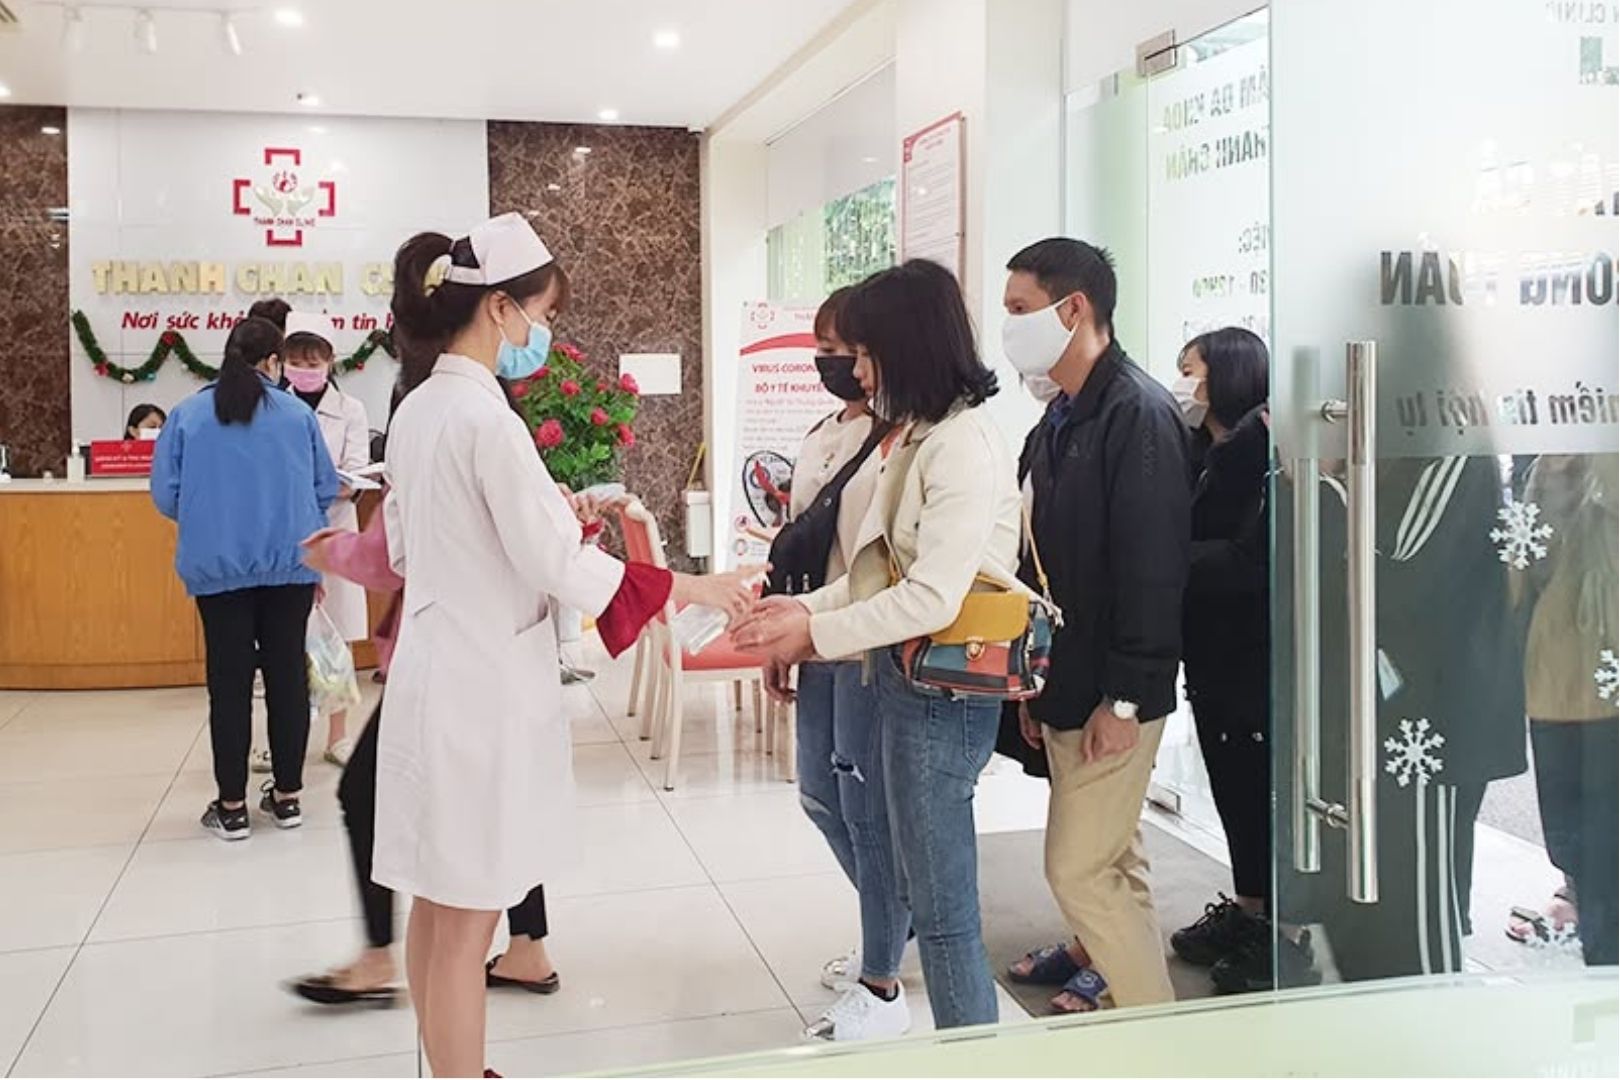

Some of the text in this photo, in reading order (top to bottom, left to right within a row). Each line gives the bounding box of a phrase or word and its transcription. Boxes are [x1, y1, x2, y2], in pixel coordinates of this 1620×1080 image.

[91, 260, 226, 295] THANH
[236, 261, 343, 296] CHAN
[121, 311, 160, 330] Nơi
[166, 310, 200, 330] sức
[206, 309, 246, 330] khỏ
[352, 312, 378, 330] tin
